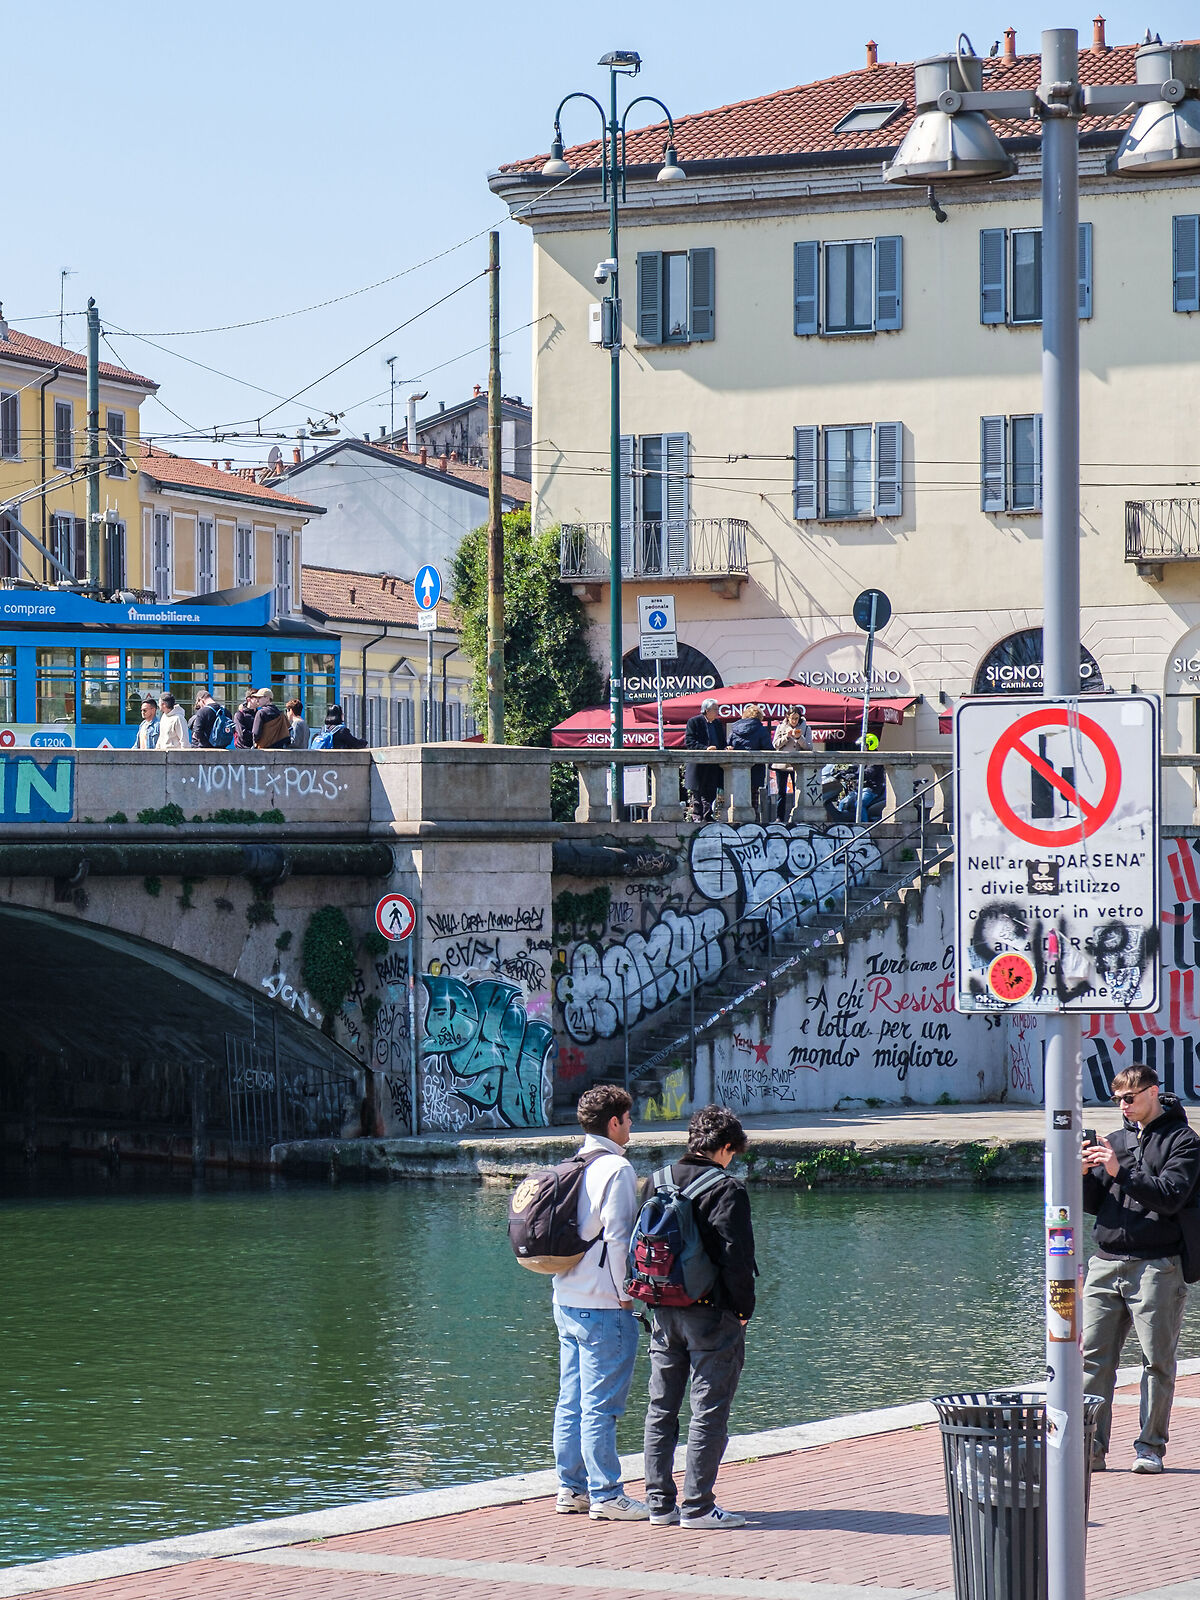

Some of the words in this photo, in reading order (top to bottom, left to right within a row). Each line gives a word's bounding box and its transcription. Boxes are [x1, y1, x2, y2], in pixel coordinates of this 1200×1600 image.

[4, 604, 56, 616] comprare
[623, 675, 716, 691] IGNORVINO
[1001, 681, 1031, 689] CANTINA
[43, 738, 65, 746] 120K
[587, 733, 655, 744] SIGNRVINO
[1073, 905, 1089, 918] in
[1098, 904, 1143, 918] vetro
[806, 984, 829, 1013] A
[837, 979, 865, 1010] chi
[800, 1018, 810, 1035] e
[817, 1010, 872, 1038] lotta
[878, 1018, 912, 1044] per
[921, 1021, 951, 1041] un
[788, 1039, 860, 1068] mondo
[872, 1040, 958, 1081] migliore
